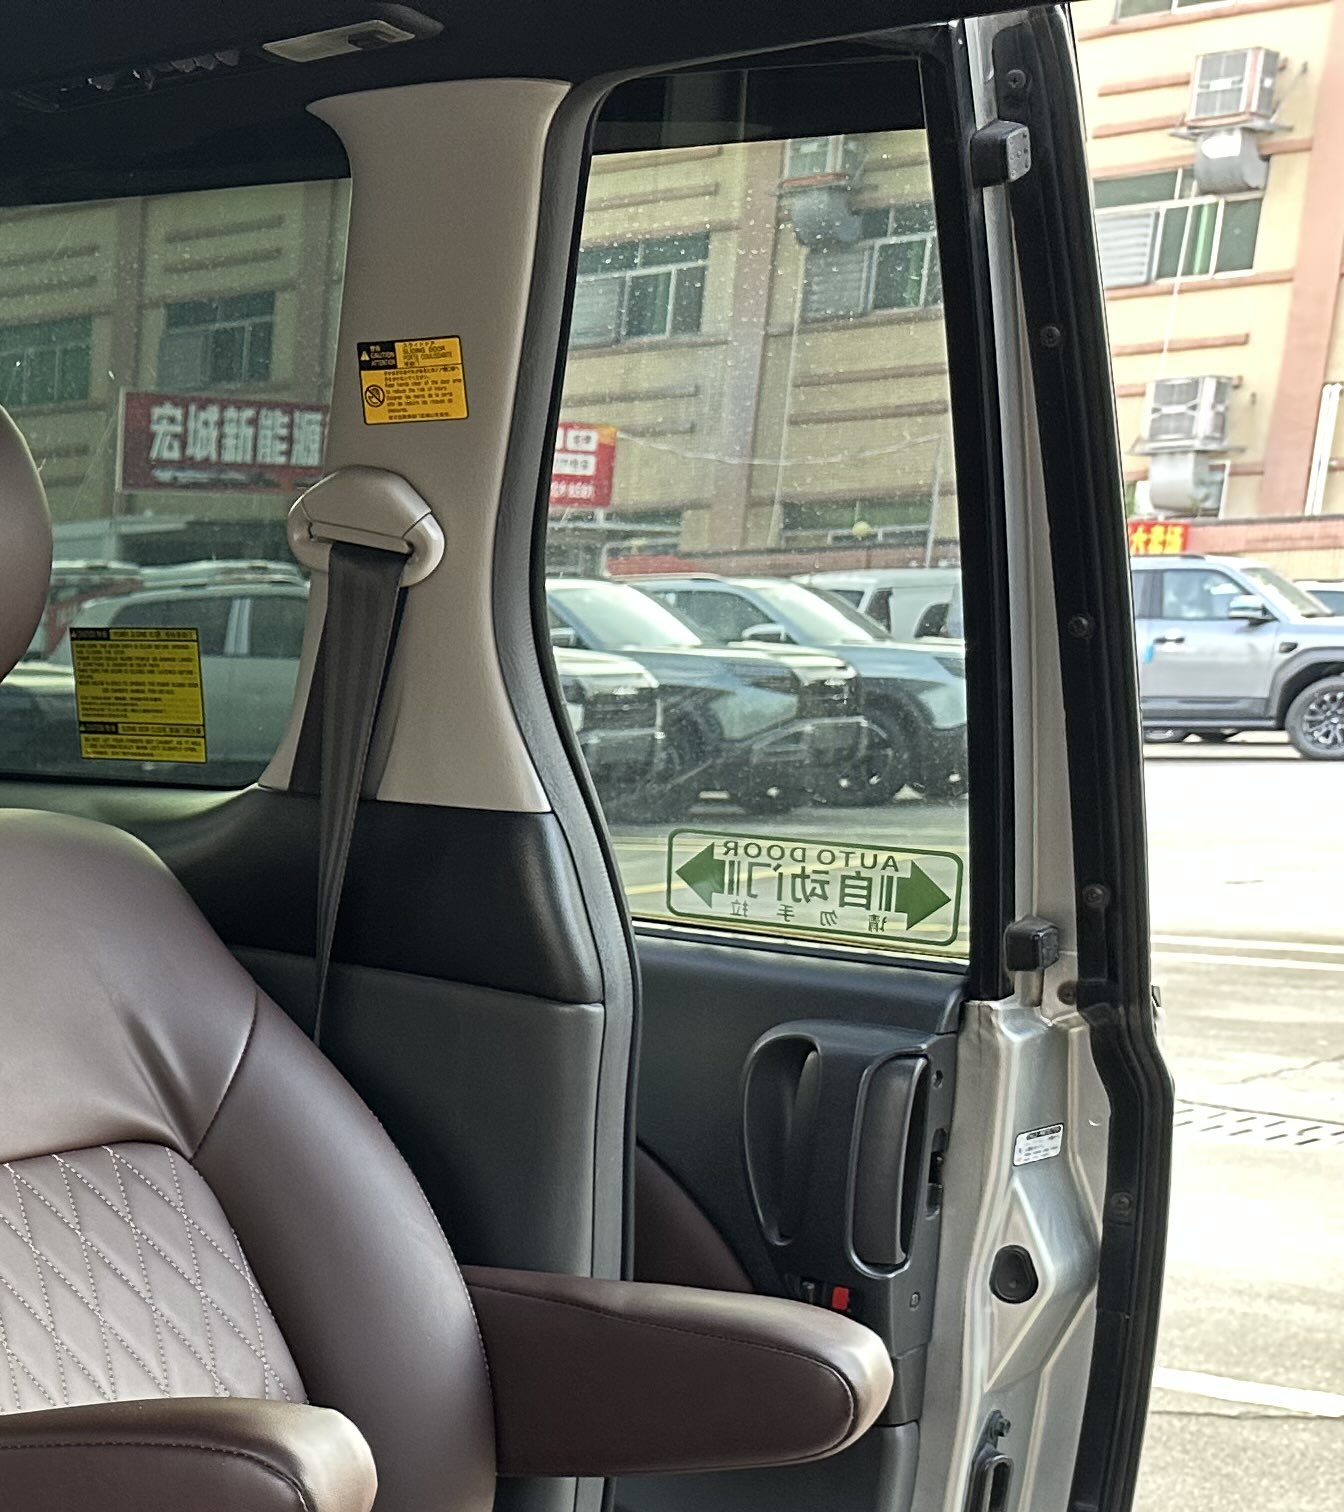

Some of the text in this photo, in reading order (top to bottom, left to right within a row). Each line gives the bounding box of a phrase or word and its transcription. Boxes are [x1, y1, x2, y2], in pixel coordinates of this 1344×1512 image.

[149, 401, 323, 467] 宏城新能源
